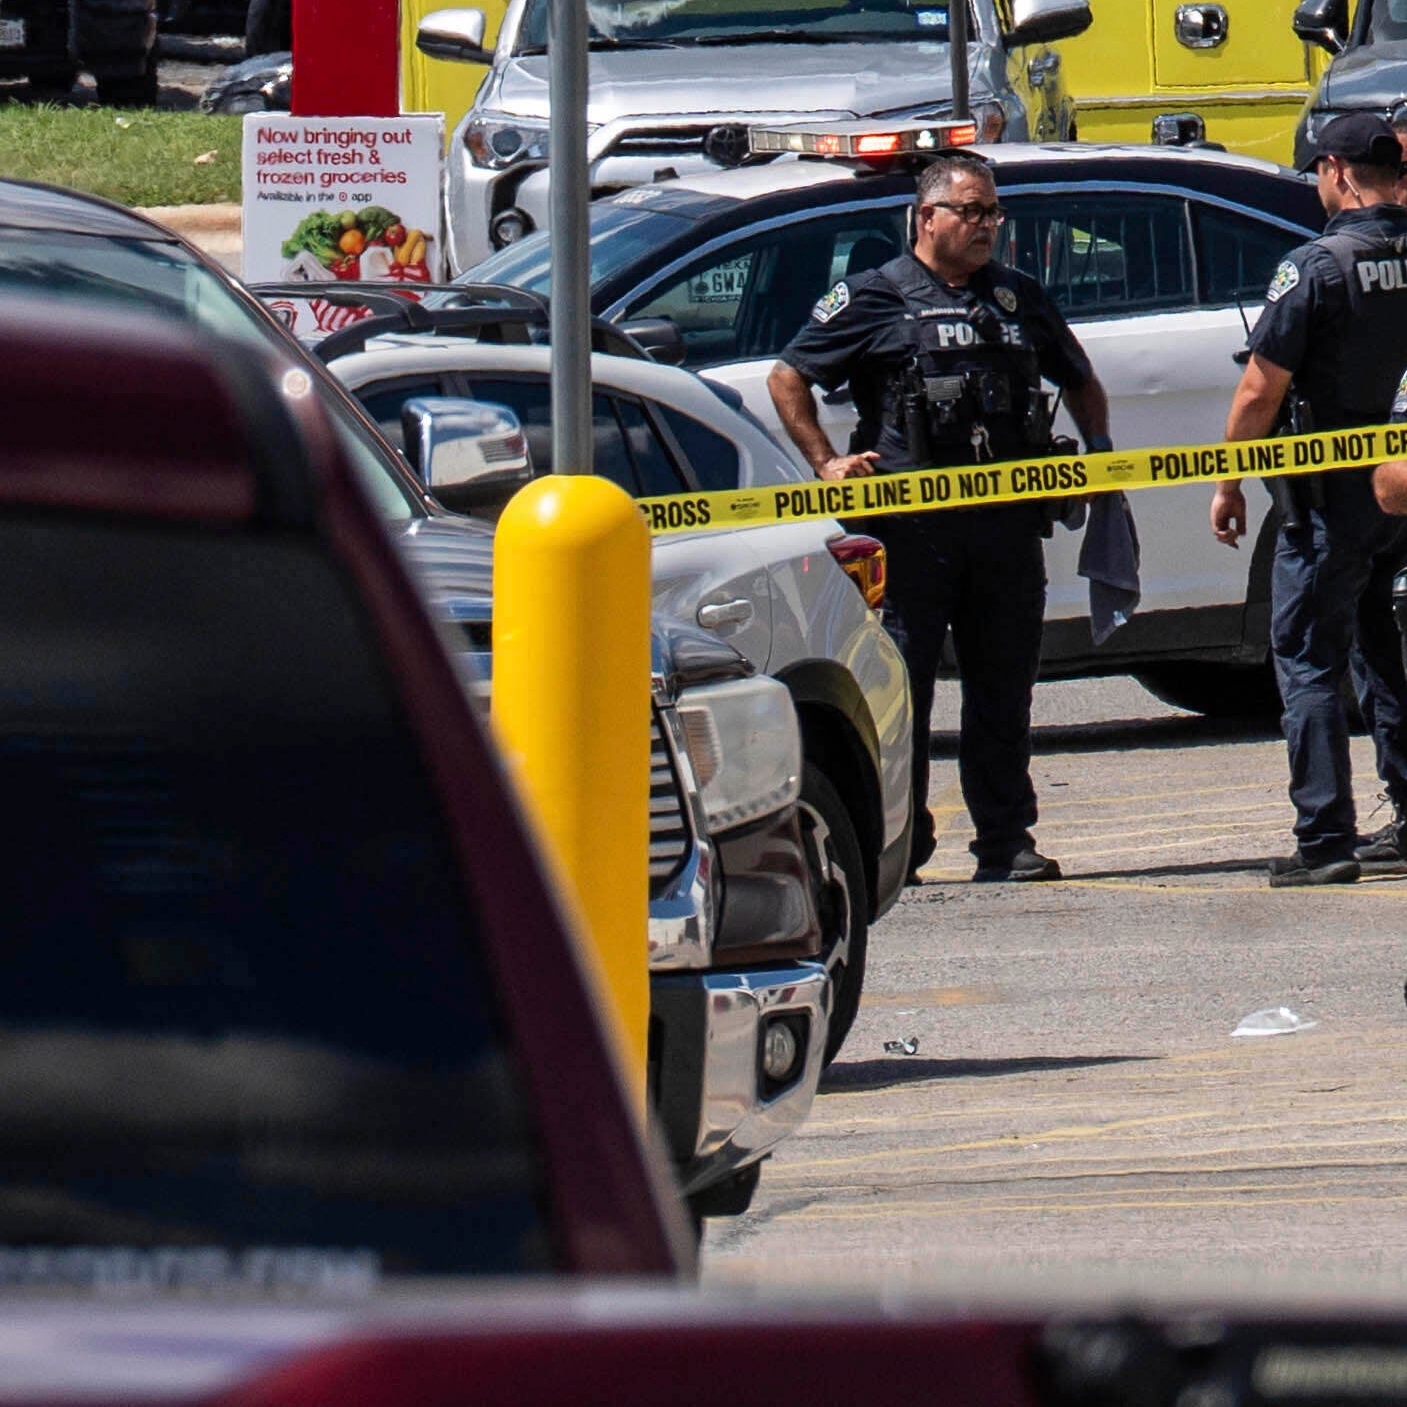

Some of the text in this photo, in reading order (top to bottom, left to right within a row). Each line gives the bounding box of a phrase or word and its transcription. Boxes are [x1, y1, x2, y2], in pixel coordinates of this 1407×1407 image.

[257, 127, 412, 148] Now bringing out
[257, 148, 381, 165] select fresh &
[256, 169, 407, 188] frozen groceries
[257, 191, 372, 202] Available in the app
[1150, 449, 1229, 480] POLICE
[1237, 444, 1285, 472] LINE
[1294, 439, 1325, 466] DO
[1334, 433, 1376, 461] NOT
[776, 484, 855, 518] POLICE
[864, 478, 911, 508] LINE
[920, 472, 951, 501] DO
[960, 469, 1001, 499] NOT
[1012, 461, 1087, 493] CROSS
